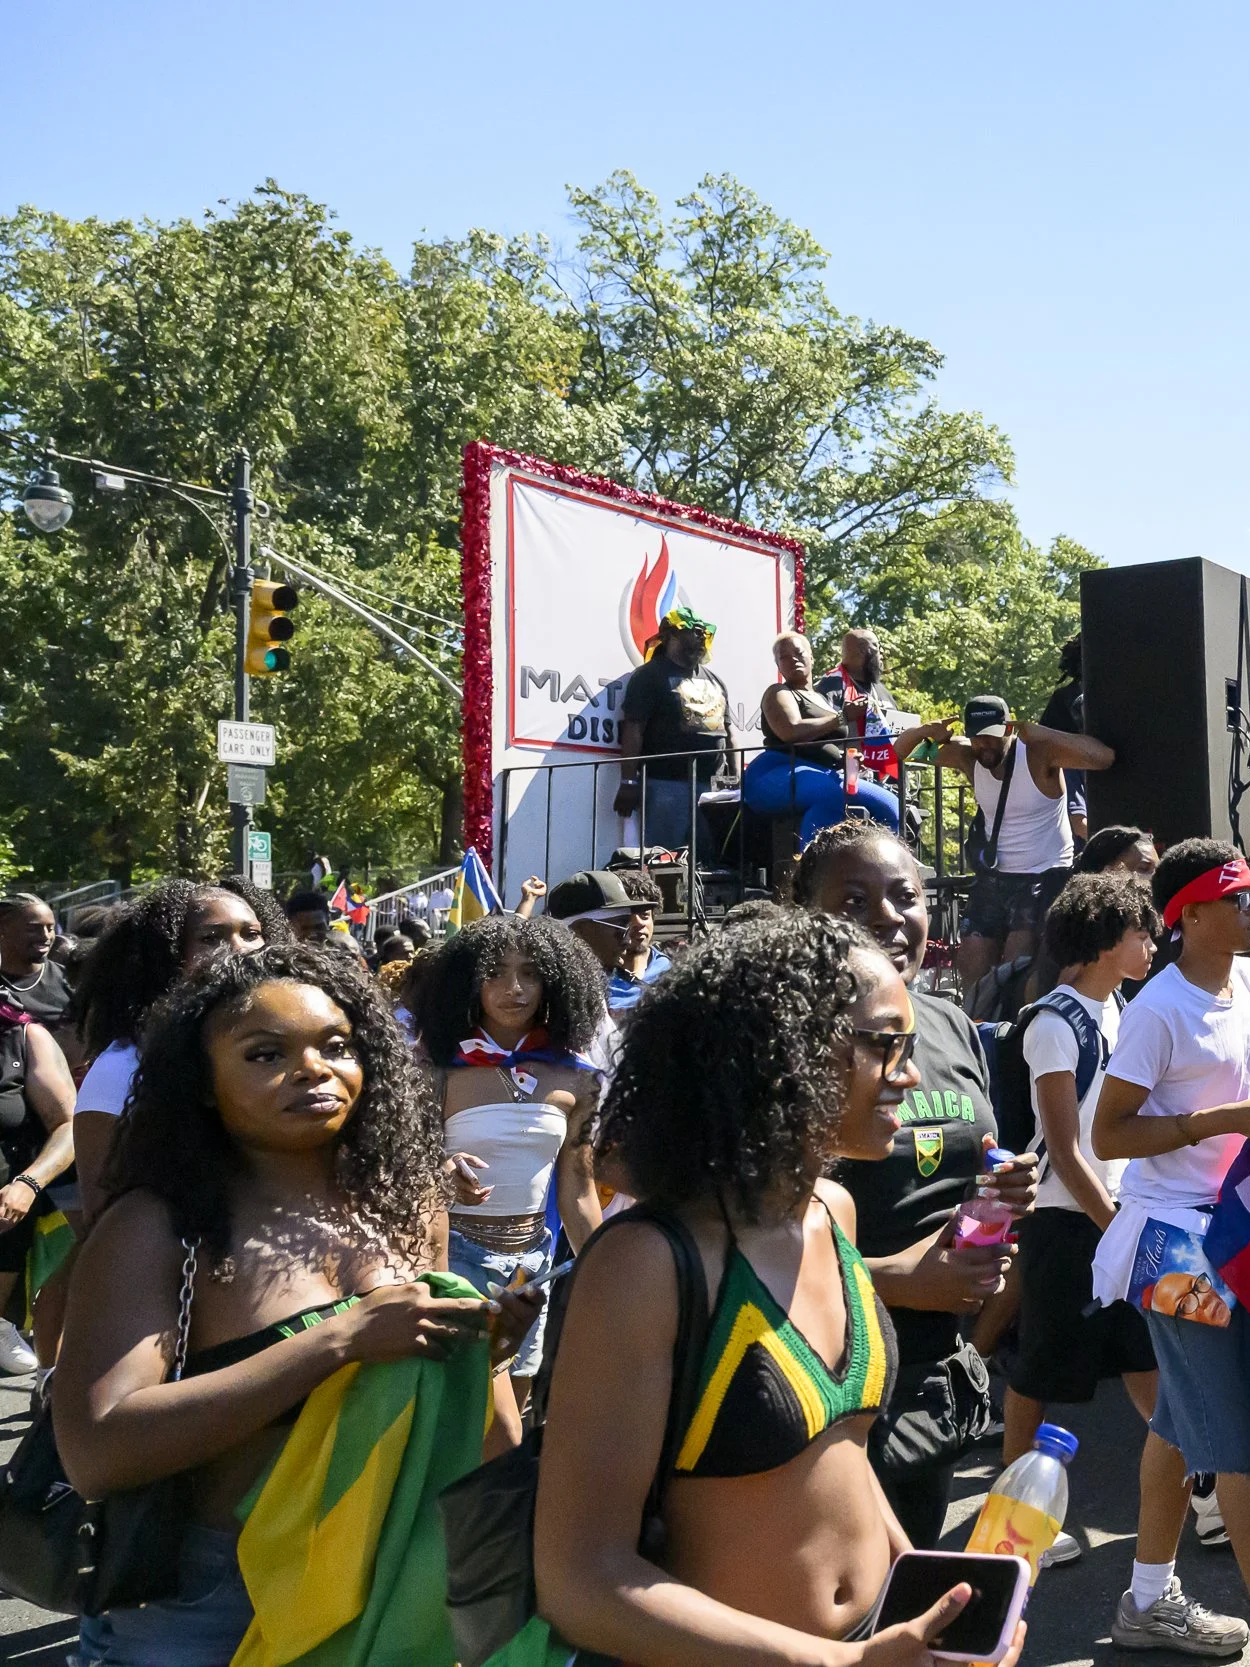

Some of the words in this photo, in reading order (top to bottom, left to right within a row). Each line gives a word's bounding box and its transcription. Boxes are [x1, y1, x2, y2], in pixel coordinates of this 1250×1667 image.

[223, 727, 270, 742] PASSENGER
[223, 743, 245, 755] CARS
[250, 745, 270, 757] ONLY
[1145, 1229, 1167, 1278] Hearts
